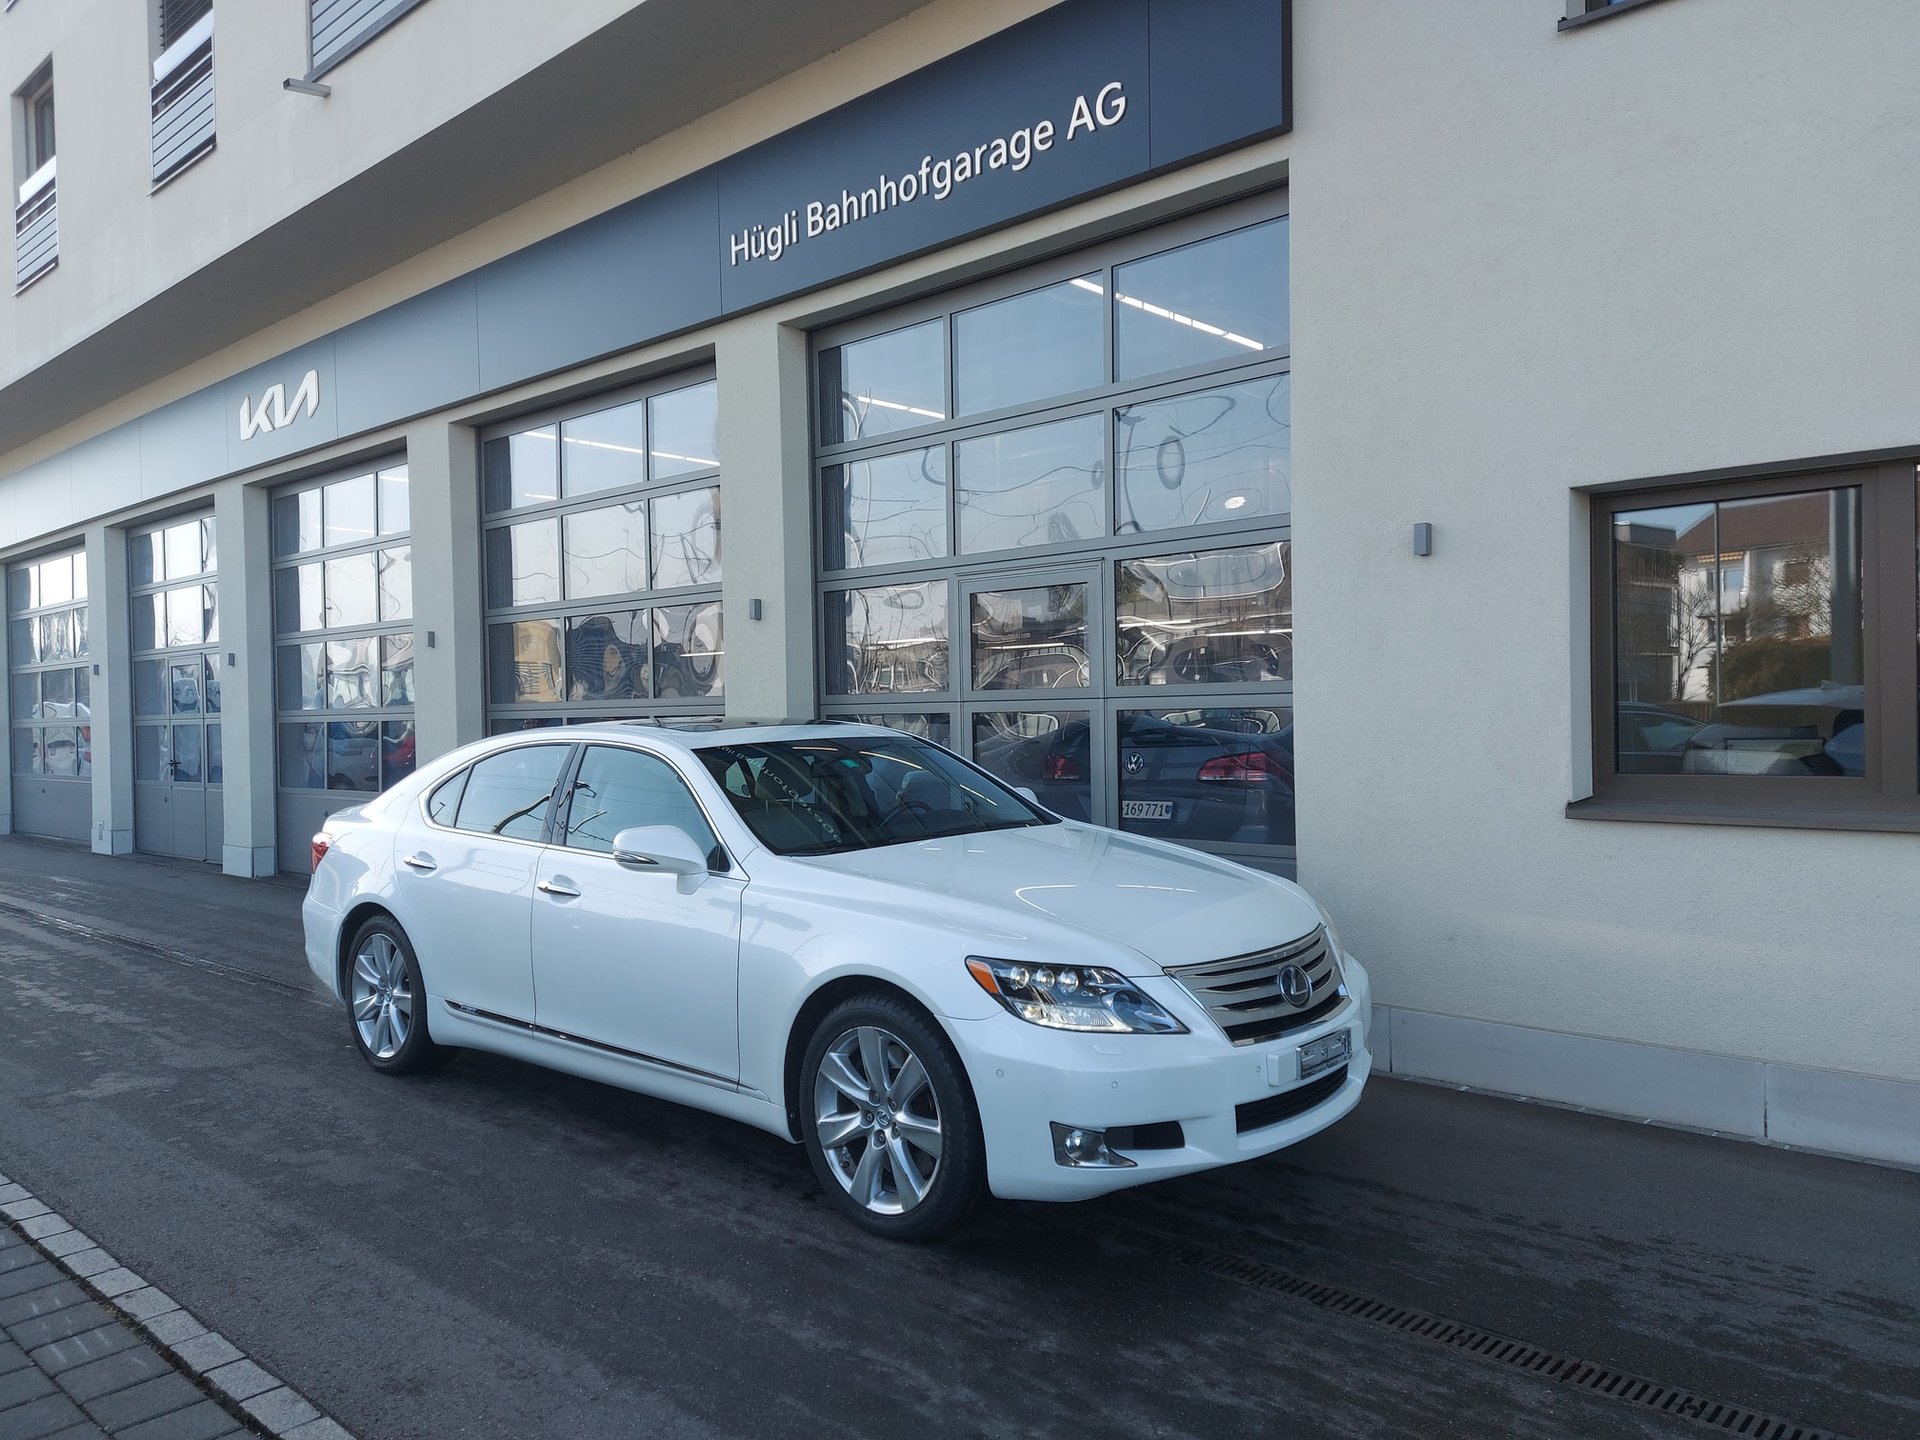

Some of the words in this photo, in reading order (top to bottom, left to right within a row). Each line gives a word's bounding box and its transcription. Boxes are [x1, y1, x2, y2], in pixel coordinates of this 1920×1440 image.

[730, 210, 798, 266] Hügli
[806, 120, 1055, 238] Bahnhofgarage
[1066, 81, 1127, 140] AG
